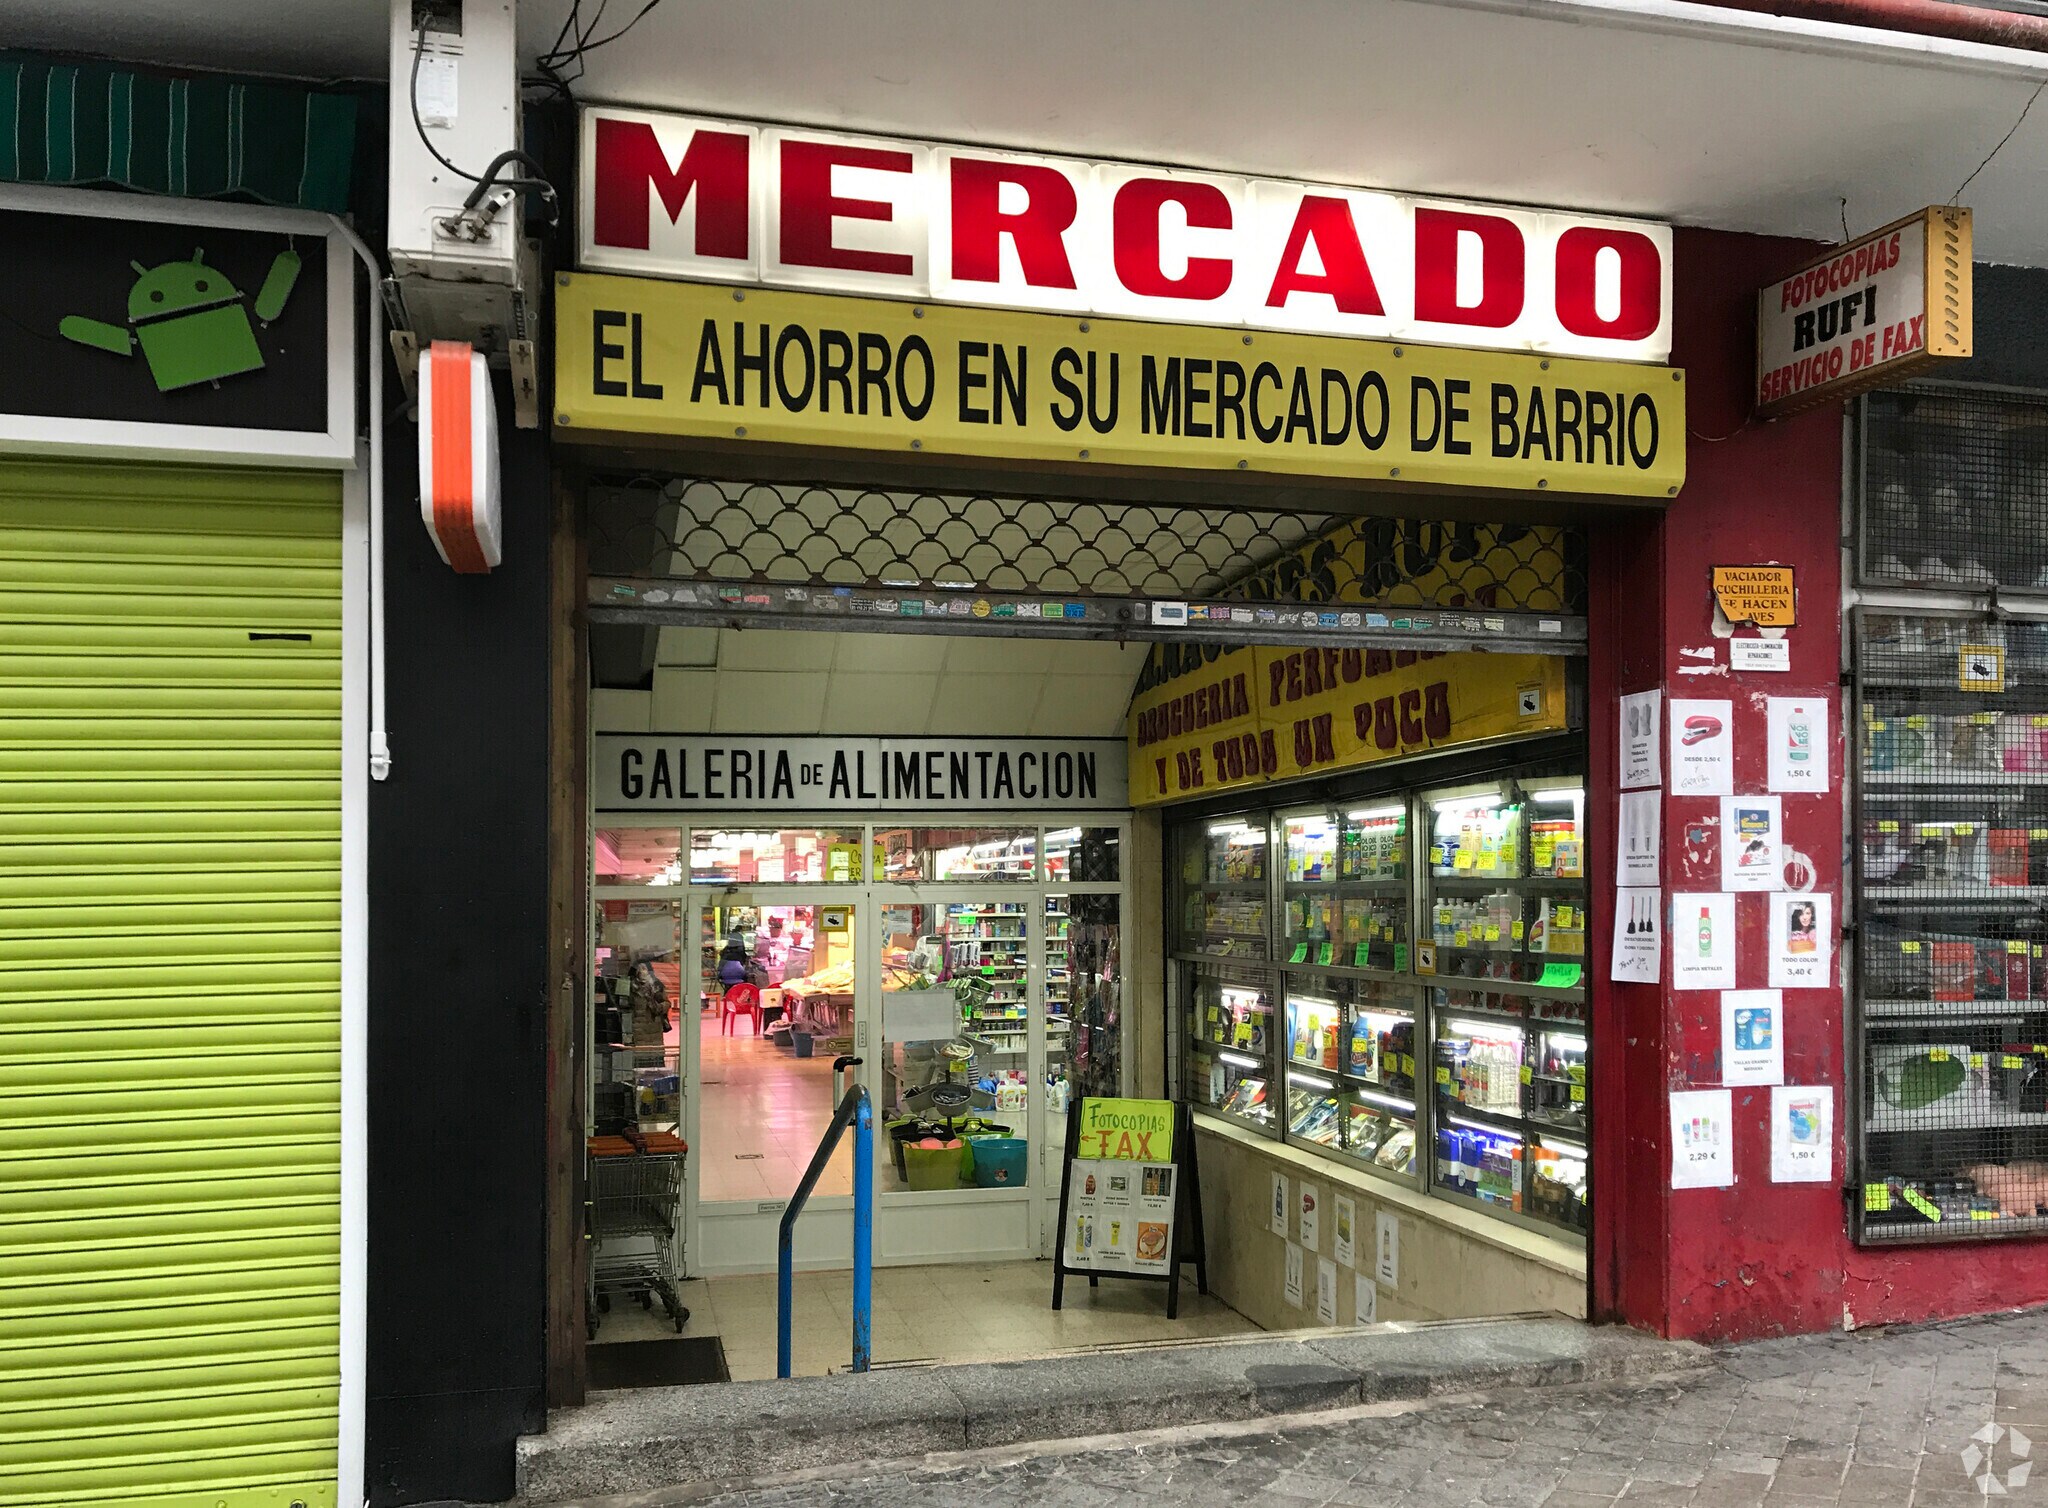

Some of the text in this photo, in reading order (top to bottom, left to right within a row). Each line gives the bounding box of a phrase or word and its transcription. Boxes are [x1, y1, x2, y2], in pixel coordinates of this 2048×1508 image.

[594, 118, 1661, 341] MERCADO
[1781, 232, 1901, 313] FOTOCOPIAS
[1793, 285, 1877, 352] RUFI
[1761, 313, 1924, 403] SERVICIO DE FAX
[593, 310, 1658, 469] EL AHORRO EN SU MERCADO DE BARRIO
[1716, 585, 1789, 595] CUCHILLERIA
[1724, 572, 1781, 582] VACIADOR
[1743, 599, 1787, 609] HACEN
[1137, 673, 1250, 748] DROGUERIA
[1156, 681, 1451, 794] Y DE TODO UN POCO
[620, 748, 1098, 800] GALERIA DE ALIMENTACION
[1787, 770, 1804, 778] 1,50
[1787, 968, 1804, 976] 3,40
[1089, 1103, 1166, 1132] FOTOCOPIAS
[1096, 1130, 1153, 1160] FAX
[1690, 1152, 1716, 1162] 2,29 €
[1790, 1152, 1808, 1160] 1,50
